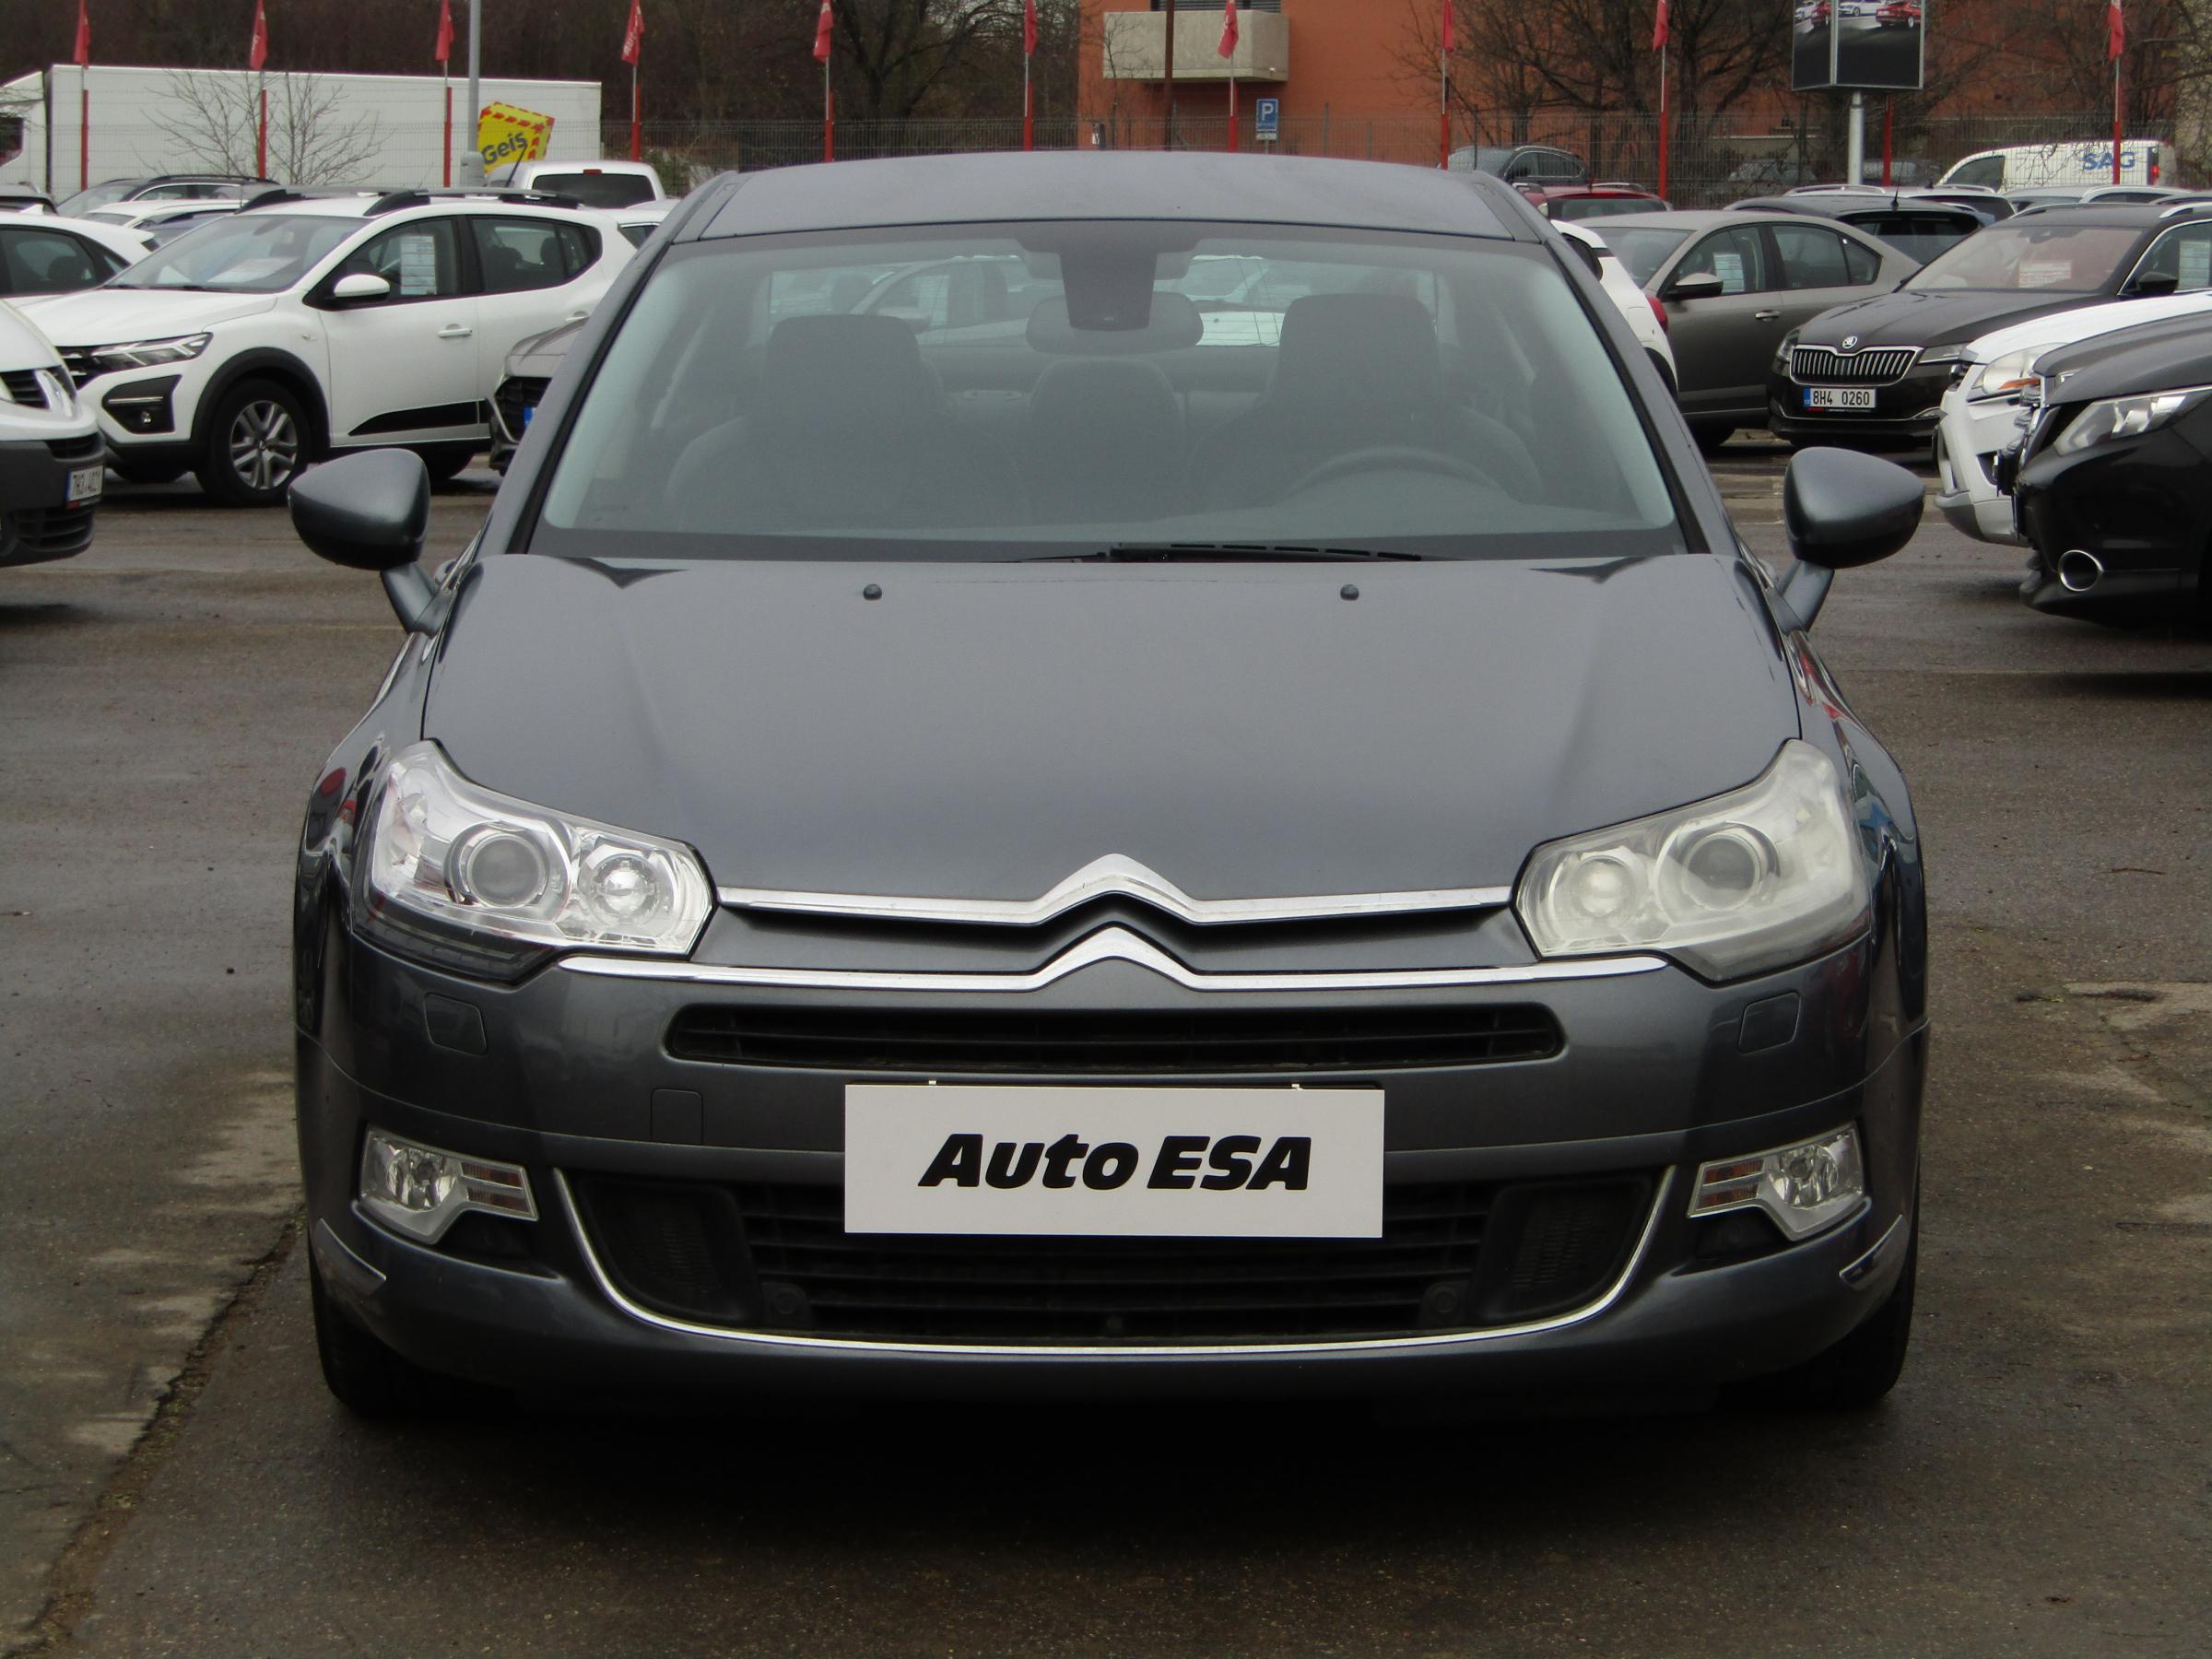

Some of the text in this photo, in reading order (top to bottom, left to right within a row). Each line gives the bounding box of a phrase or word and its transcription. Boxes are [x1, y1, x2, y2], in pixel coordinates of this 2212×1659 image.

[1262, 102, 1274, 121] P
[481, 132, 528, 165] Geis
[2082, 151, 2136, 171] SAG
[1813, 390, 1870, 406] 8H4 0260
[918, 1134, 1312, 1191] Auto ESA
